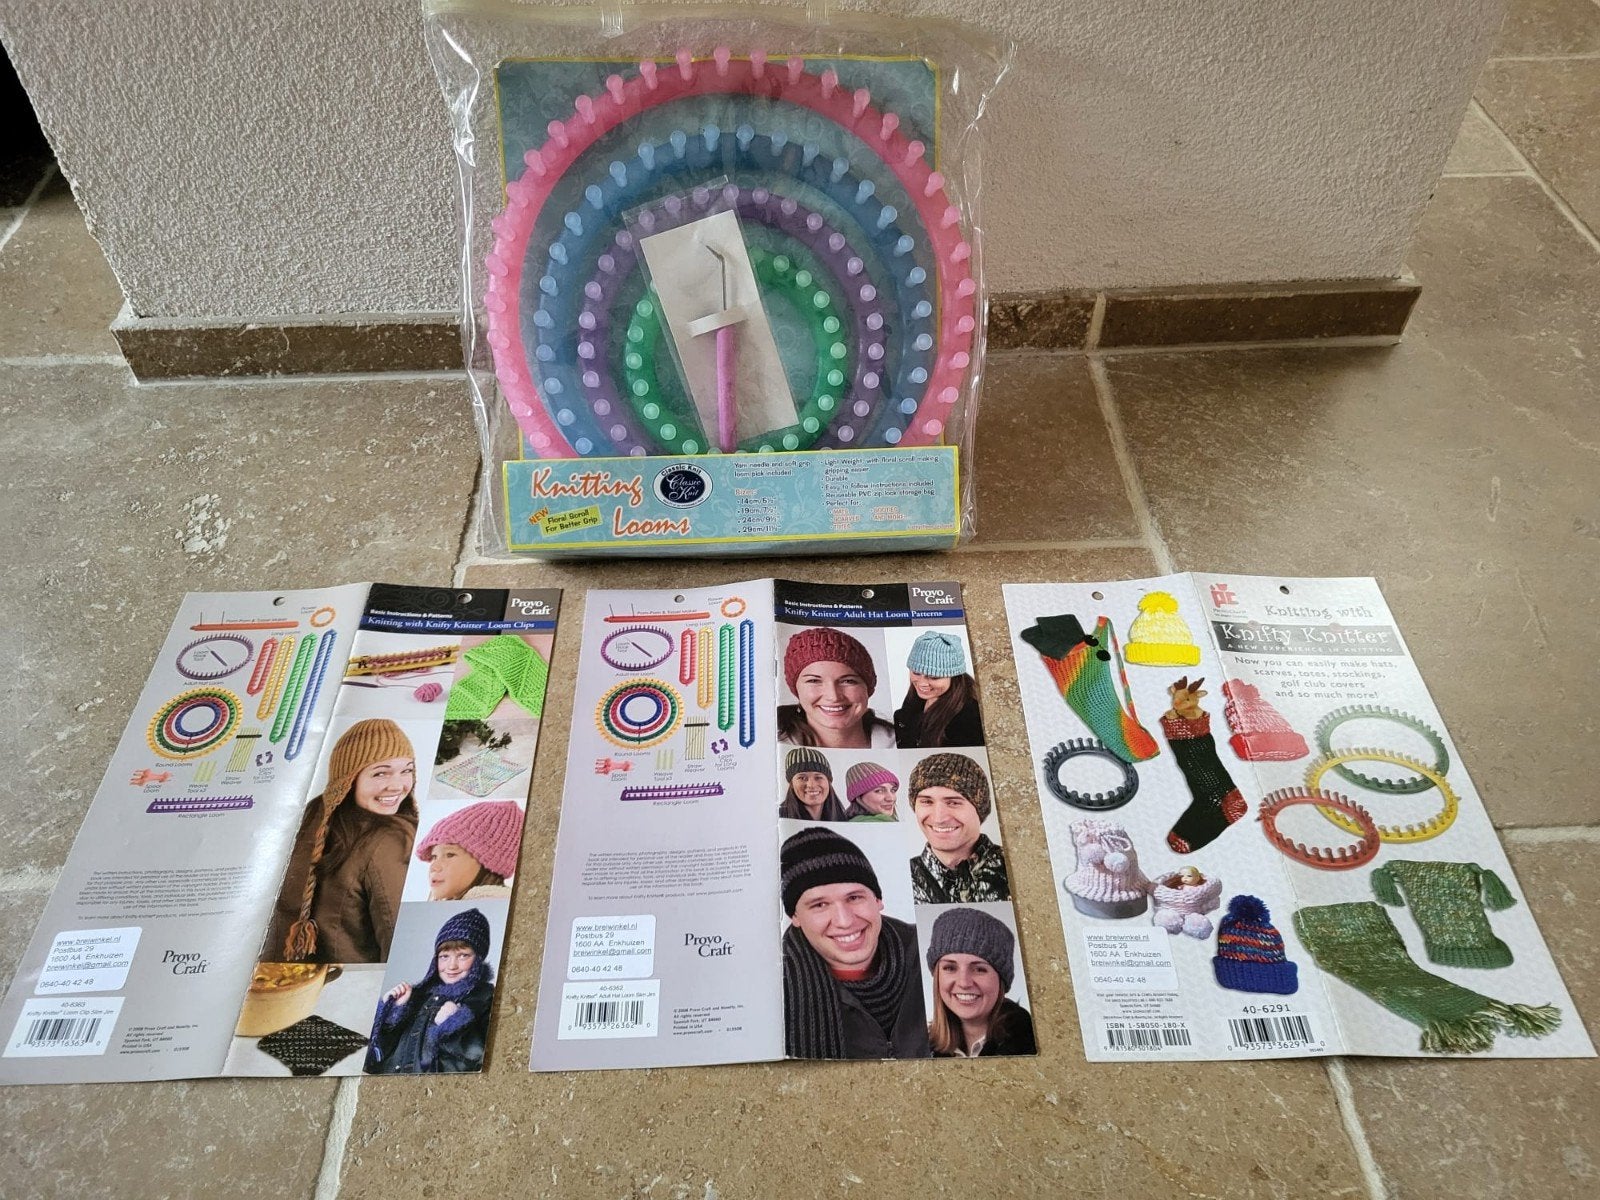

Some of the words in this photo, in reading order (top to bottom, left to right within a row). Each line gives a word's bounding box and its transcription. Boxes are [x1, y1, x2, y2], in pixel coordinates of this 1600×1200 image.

[533, 469, 642, 505] Knitting
[666, 474, 701, 489] Classic
[669, 486, 699, 500] Knit
[528, 508, 550, 525] NEW
[547, 513, 567, 524] Floral
[569, 509, 590, 520] Scroll
[614, 507, 690, 536] Looms
[545, 524, 558, 534] For
[560, 520, 582, 531] Better
[583, 516, 598, 527] Grip
[911, 587, 944, 597] Provo
[510, 598, 544, 608] Provo
[924, 594, 956, 605] Craft
[386, 610, 422, 618] Instructions
[521, 606, 553, 616] Craft
[784, 606, 810, 618] Knifty
[1264, 606, 1332, 620] Knitting
[1336, 606, 1374, 618] with
[368, 616, 403, 628] Knitting
[426, 620, 452, 630] Knifty
[514, 622, 534, 630] Clips
[1220, 624, 1292, 646] Knifty
[1300, 626, 1389, 644] Knitter
[1234, 656, 1259, 664] Now
[1308, 660, 1336, 668] easily
[1254, 669, 1296, 677] scarves,
[1332, 670, 1386, 679] stockings,
[1280, 680, 1300, 688] golf
[1347, 691, 1379, 699] more!
[684, 933, 722, 946] Provo
[573, 948, 652, 957] breiwinkel@gmail.com
[698, 942, 733, 958] Craft
[162, 950, 200, 964] Provo
[1091, 958, 1172, 968] breiwinkel@gmail.com
[46, 961, 128, 972] breiwinkel@gmail.com
[172, 960, 207, 975] Craft
[40, 980, 70, 988] 0640-40
[1242, 1004, 1291, 1014] 40-6291
[1244, 1042, 1272, 1050] 93573
[1277, 1041, 1306, 1049] 36291
